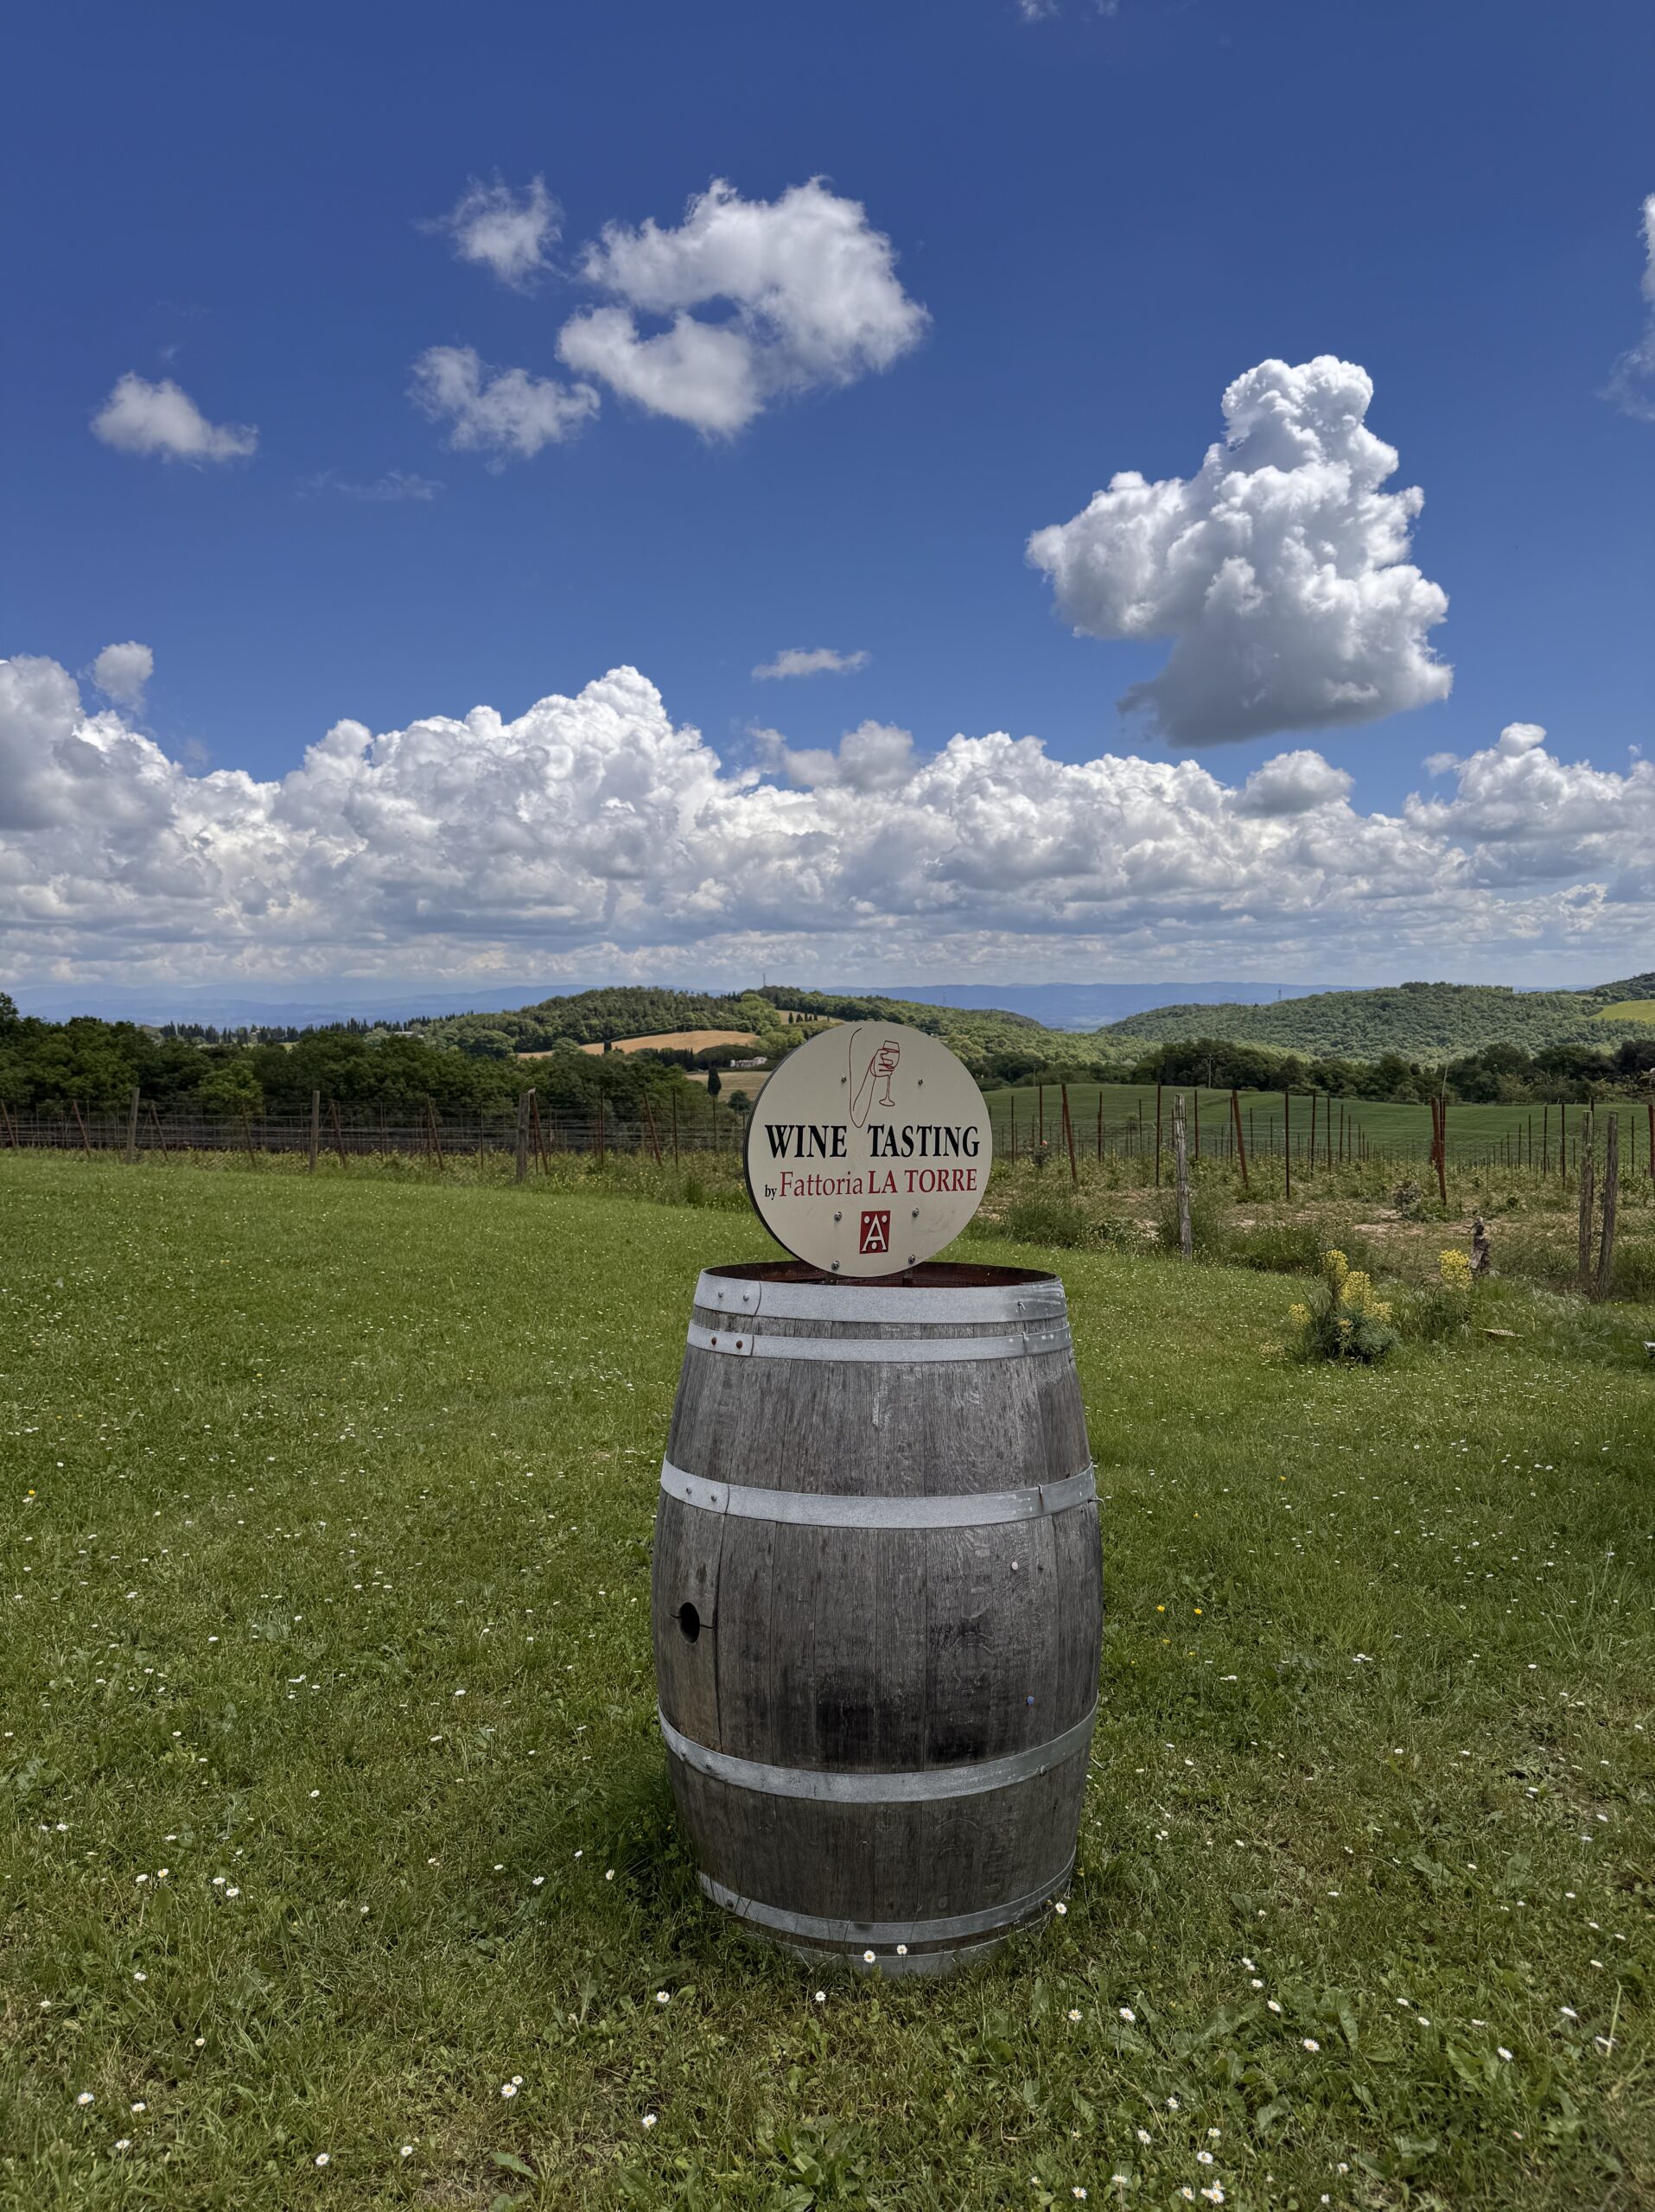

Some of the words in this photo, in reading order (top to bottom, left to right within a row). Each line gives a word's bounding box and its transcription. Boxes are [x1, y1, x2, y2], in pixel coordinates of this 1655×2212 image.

[765, 1124, 848, 1159] WINE
[868, 1123, 980, 1158] TASTING
[764, 1184, 778, 1201] by
[779, 1171, 863, 1197] Fattoria
[868, 1170, 898, 1194] LA
[904, 1168, 977, 1192] TORRE
